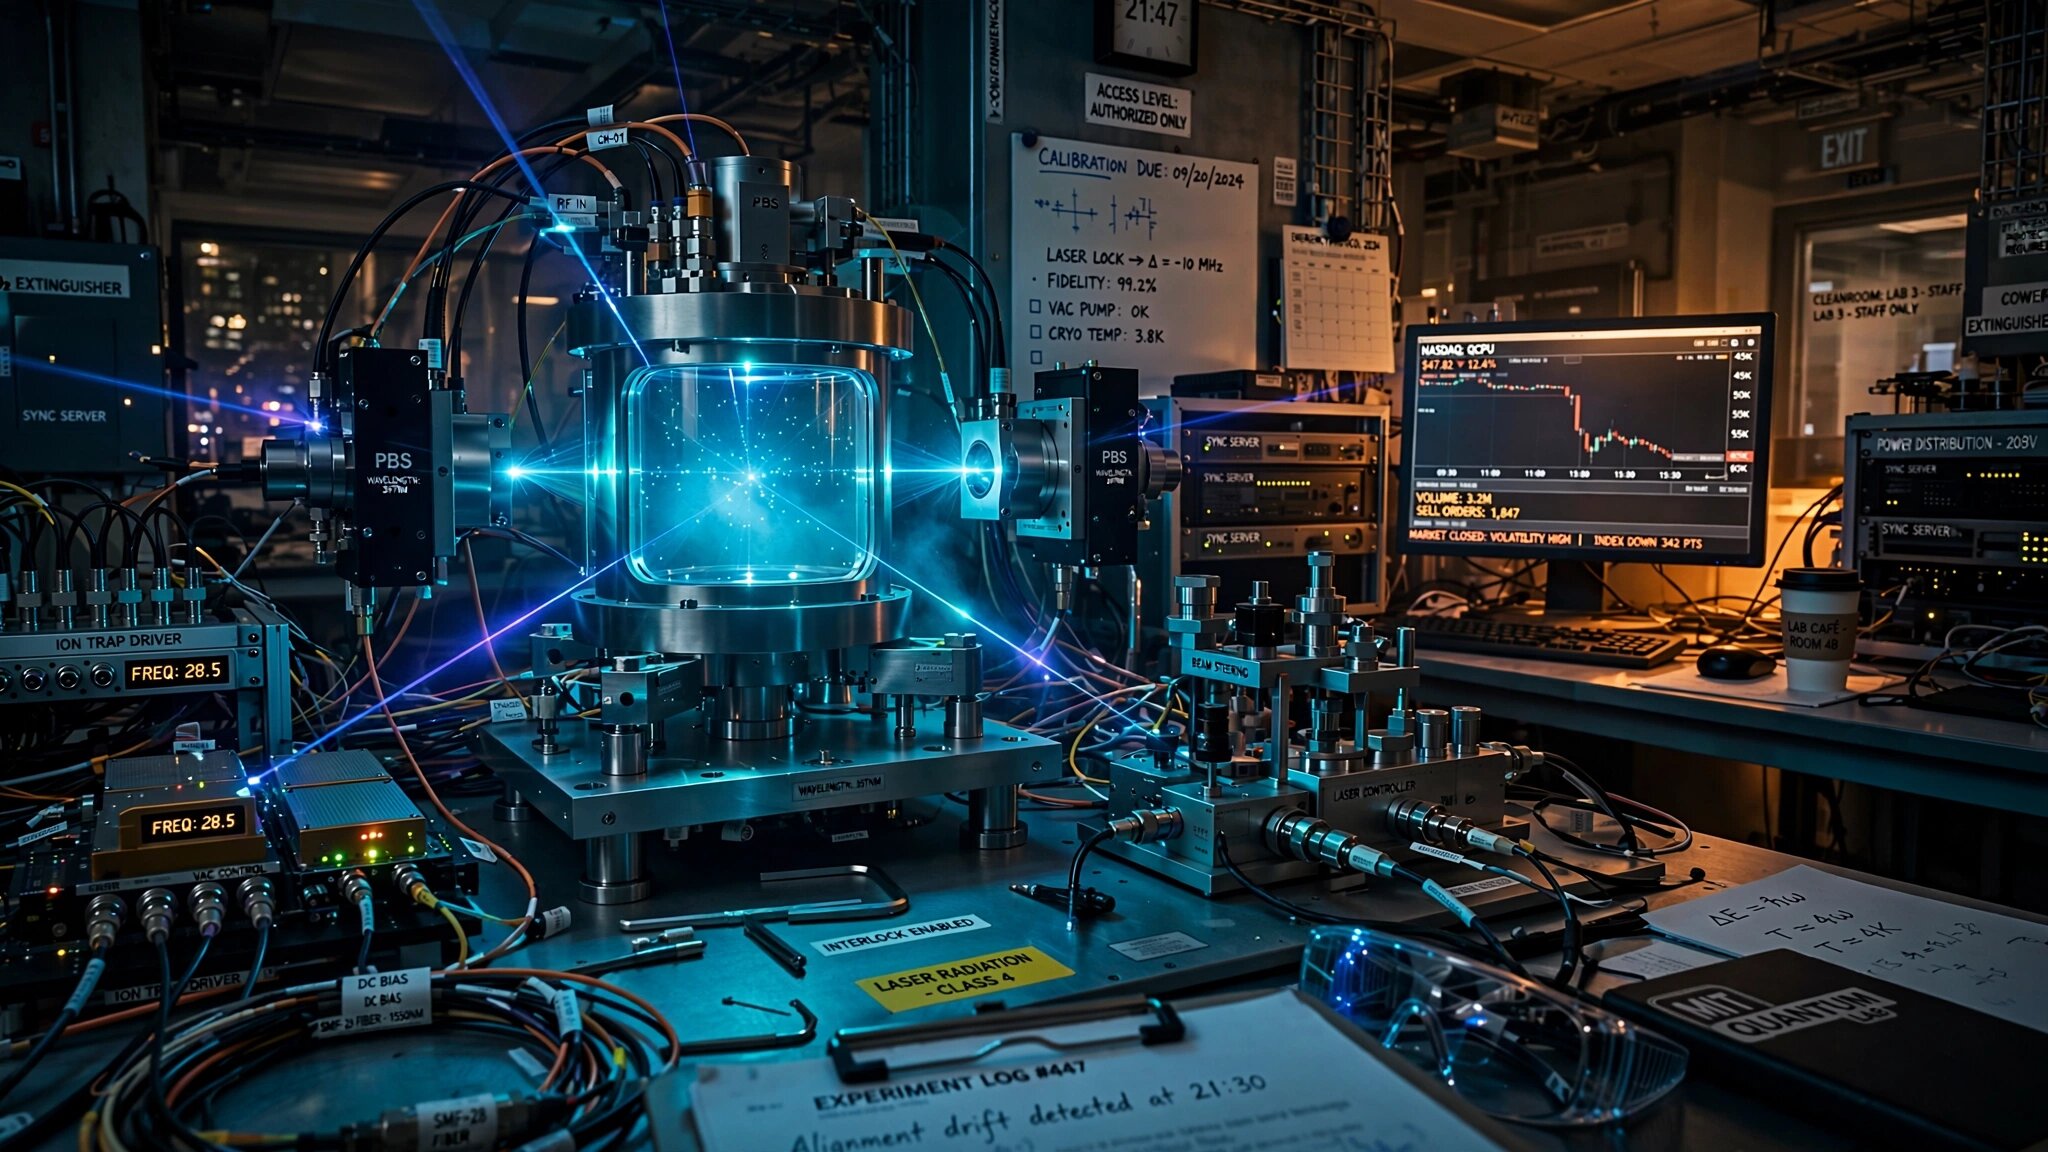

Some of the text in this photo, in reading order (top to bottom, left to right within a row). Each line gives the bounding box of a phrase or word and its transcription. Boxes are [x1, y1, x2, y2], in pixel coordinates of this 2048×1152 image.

[1126, 0, 1178, 27] 21:47
[1097, 83, 1178, 109] ACCESS LEVEL:
[1091, 103, 1187, 130] AUTHORIZED ONLY
[1821, 128, 1868, 169] EXIT
[1039, 147, 1127, 174] CALIBRATION
[1137, 159, 1168, 179] DUE:
[1173, 163, 1244, 190] 09/20/2024
[557, 198, 587, 209] RF IN
[752, 197, 779, 209] PBS
[1047, 247, 1087, 264] LASER
[1093, 250, 1124, 266] LOCK
[1199, 258, 1223, 273] MHz
[16, 276, 122, 295] EXTINGUISHER
[1048, 272, 1157, 293] FIDELITY: 99.2%
[1887, 287, 1908, 301] LAB
[1912, 287, 1918, 298] 3
[1928, 283, 1963, 296] STAFF
[1049, 301, 1150, 318] VAC PUMP: OK
[1813, 309, 1834, 322] LAB
[1837, 309, 1844, 319] 3
[1855, 305, 1886, 319] STAFF
[1890, 303, 1919, 316] ONLY
[1049, 326, 1165, 344] CRYO TEMP: 3.8K
[1421, 343, 1464, 356] NASDAQ:
[1468, 359, 1497, 370] 12.4%
[23, 410, 107, 422] SYNC SERVER
[1206, 435, 1260, 448] SYNC SERVER
[1915, 436, 1993, 451] DISTRIBUTION
[376, 452, 412, 469] PBS
[1102, 450, 1127, 464] PBS
[1204, 472, 1254, 483] SYNC SERVER
[1884, 464, 1937, 474] SYNC SERVER
[1416, 492, 1492, 504] VOLUME: 3.2M
[1416, 506, 1520, 520] SELL ORDERS: 1,847
[1206, 532, 1260, 544] SYNC SERVER
[1409, 529, 1702, 549] MARKET CLOSED: VOLATILITY HIGH INDEX DOWN 342 PTS
[1882, 523, 1951, 537] SYNC SERVER
[1788, 621, 1807, 634] LAB
[1811, 619, 1839, 635] CAFÉ
[56, 633, 182, 650] ION TRAP DRIVER
[1790, 636, 1822, 649] ROOM
[131, 662, 221, 682] FREQ: 28.5
[1334, 781, 1416, 801] LASER CONTROLLER
[152, 813, 235, 835] FREQ: 28.5
[193, 865, 267, 881] VAC CONTROL
[823, 917, 974, 953] INTERLOCK ENABLED
[358, 973, 408, 990] DC BIAS
[873, 953, 1033, 993] LASER RADIATION
[115, 989, 141, 1001] ION
[190, 973, 241, 991] DRIVER
[937, 976, 999, 997] CLASS
[1002, 972, 1015, 984] 4
[364, 992, 402, 1007] DC BIAS
[1671, 992, 1755, 1020] MIT
[1728, 992, 1880, 1036] QUANTUM
[814, 1076, 973, 1111] EXPERIMENT
[981, 1067, 1030, 1088] LOG
[1036, 1060, 1086, 1079] #447
[791, 1121, 925, 1152] Alignment
[945, 1108, 1010, 1145] drift
[1029, 1092, 1134, 1128] detected
[1149, 1086, 1175, 1107] at
[1190, 1074, 1267, 1101] 21:30
